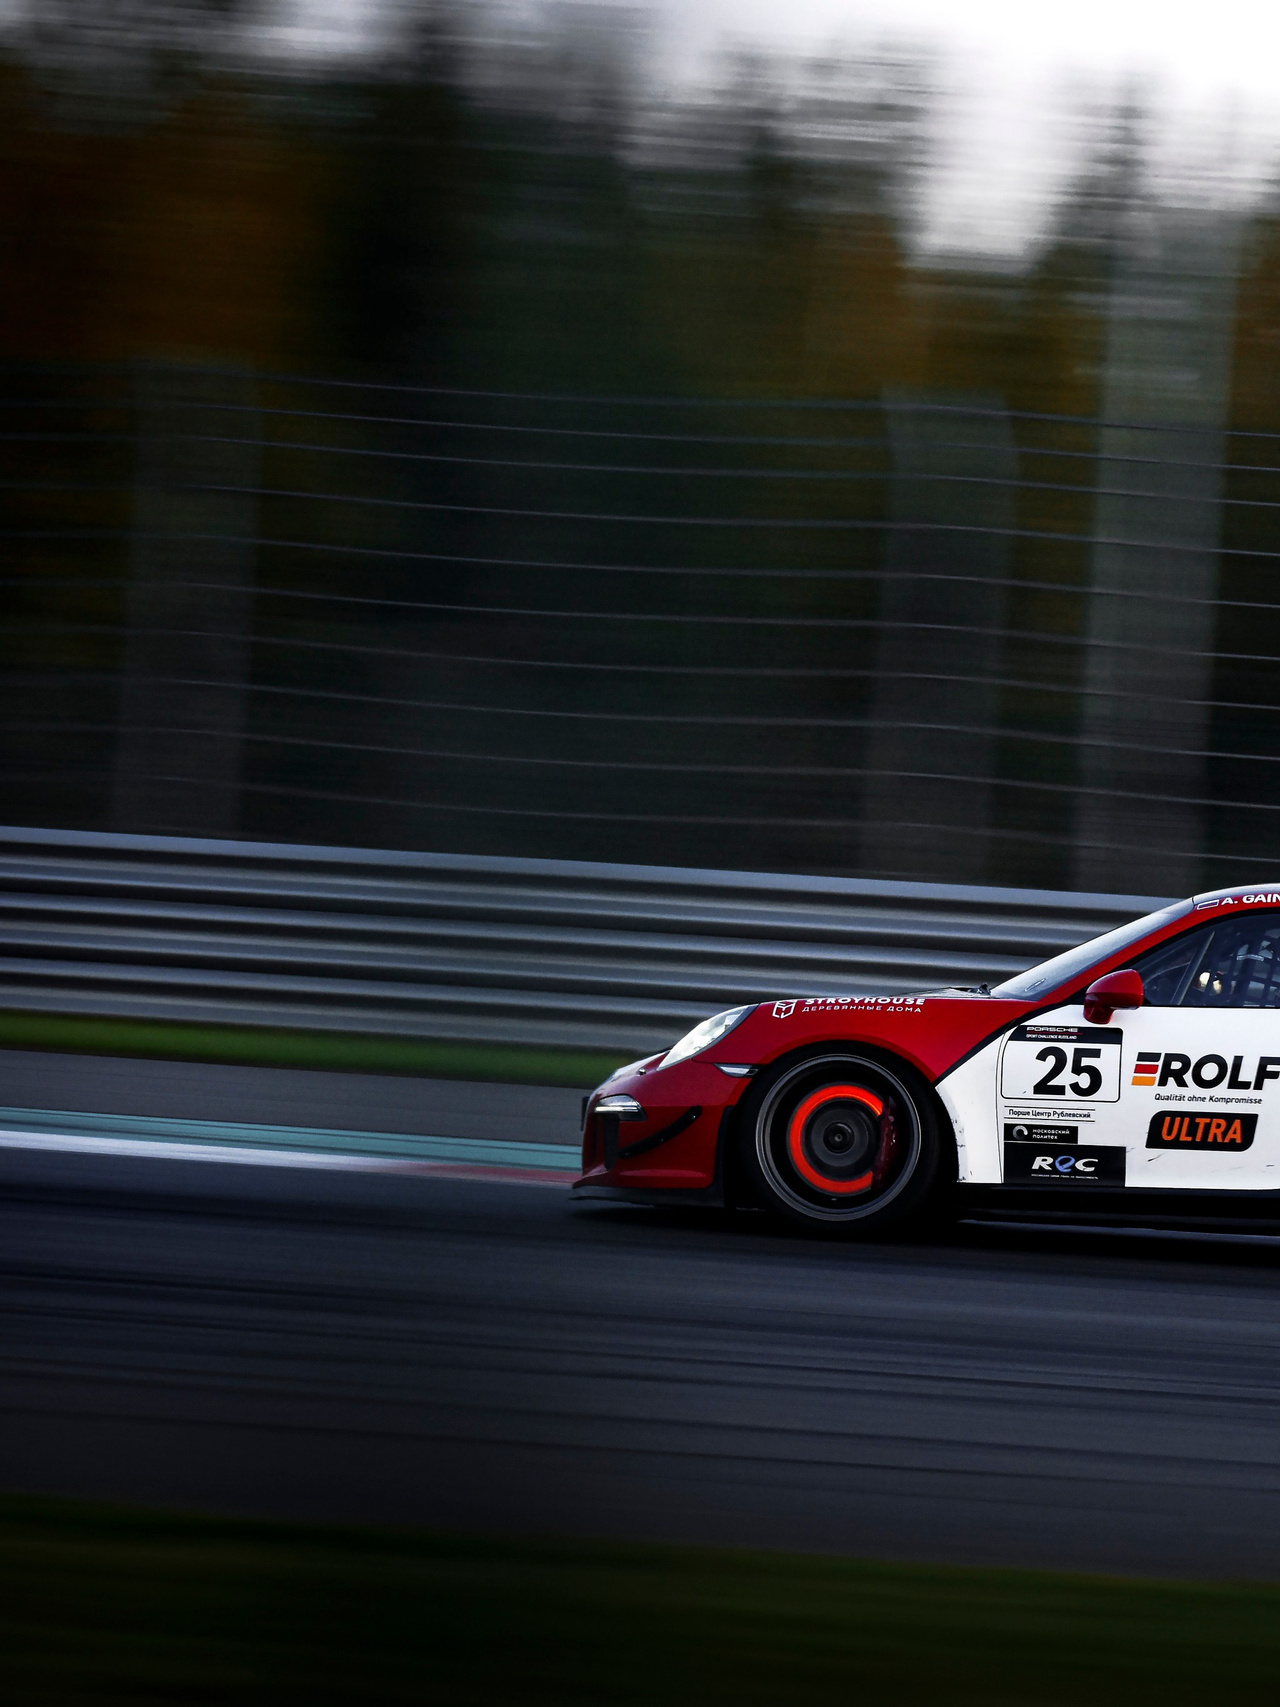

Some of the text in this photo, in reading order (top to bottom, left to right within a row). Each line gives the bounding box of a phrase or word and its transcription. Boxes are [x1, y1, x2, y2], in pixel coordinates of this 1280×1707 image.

[1221, 897, 1238, 905] A.
[804, 997, 926, 1006] STROYHOUSE
[802, 1005, 883, 1013] ДЕРЕВЯННЫЕ
[1033, 1046, 1102, 1097] 25
[1154, 1093, 1263, 1105] Qualität ohne Kompromisse
[1008, 1109, 1091, 1118] Порше Центр Рублевский
[1161, 1116, 1243, 1144] ULTRA
